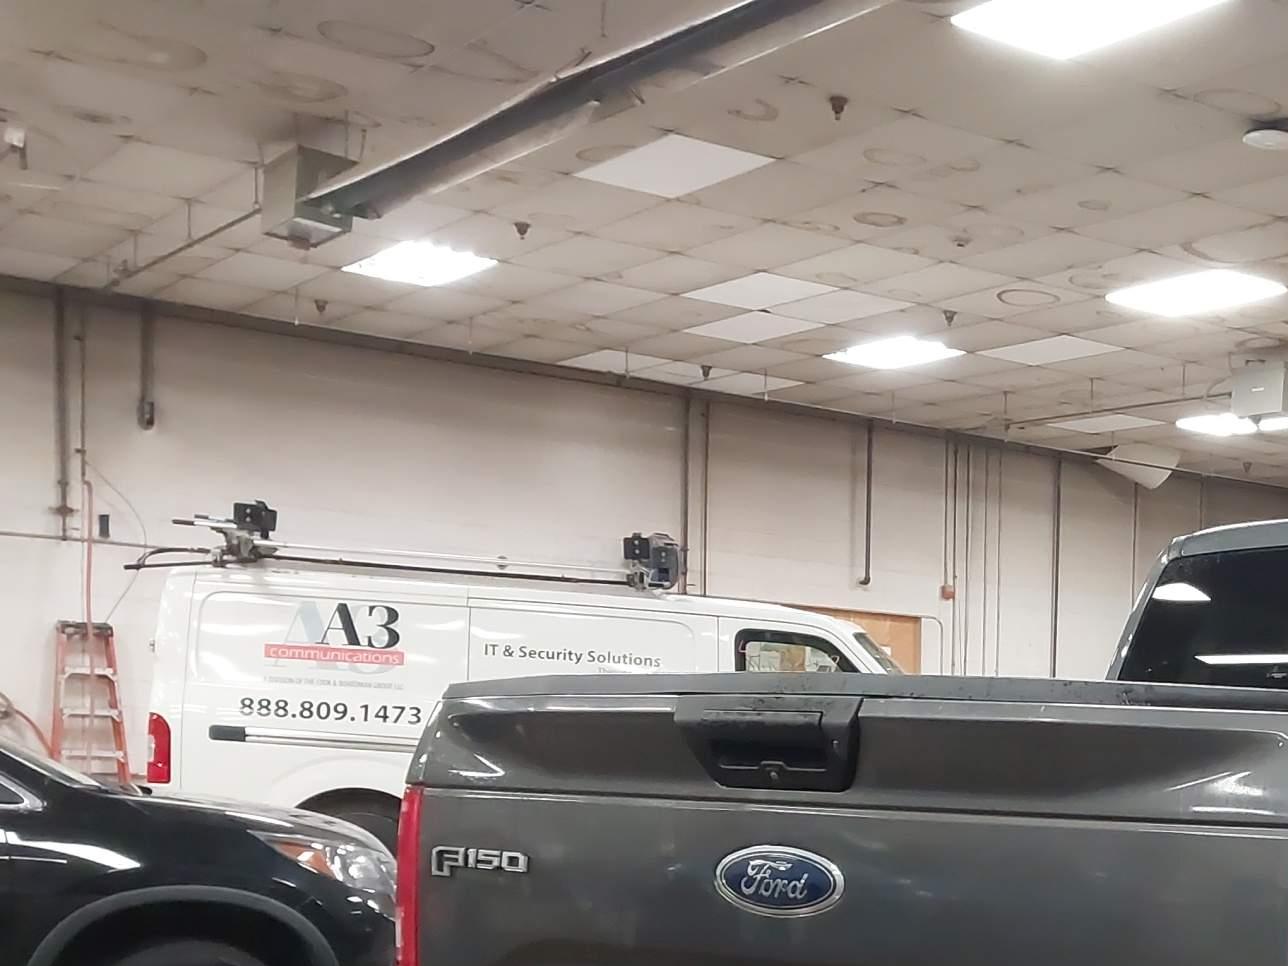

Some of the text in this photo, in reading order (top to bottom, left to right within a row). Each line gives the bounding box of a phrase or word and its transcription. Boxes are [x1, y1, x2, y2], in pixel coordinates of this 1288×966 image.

[269, 646, 400, 665] communications
[484, 643, 661, 668] IT & Security Solutions
[239, 697, 422, 725] 888.809.1473
[741, 859, 809, 899] Ford
